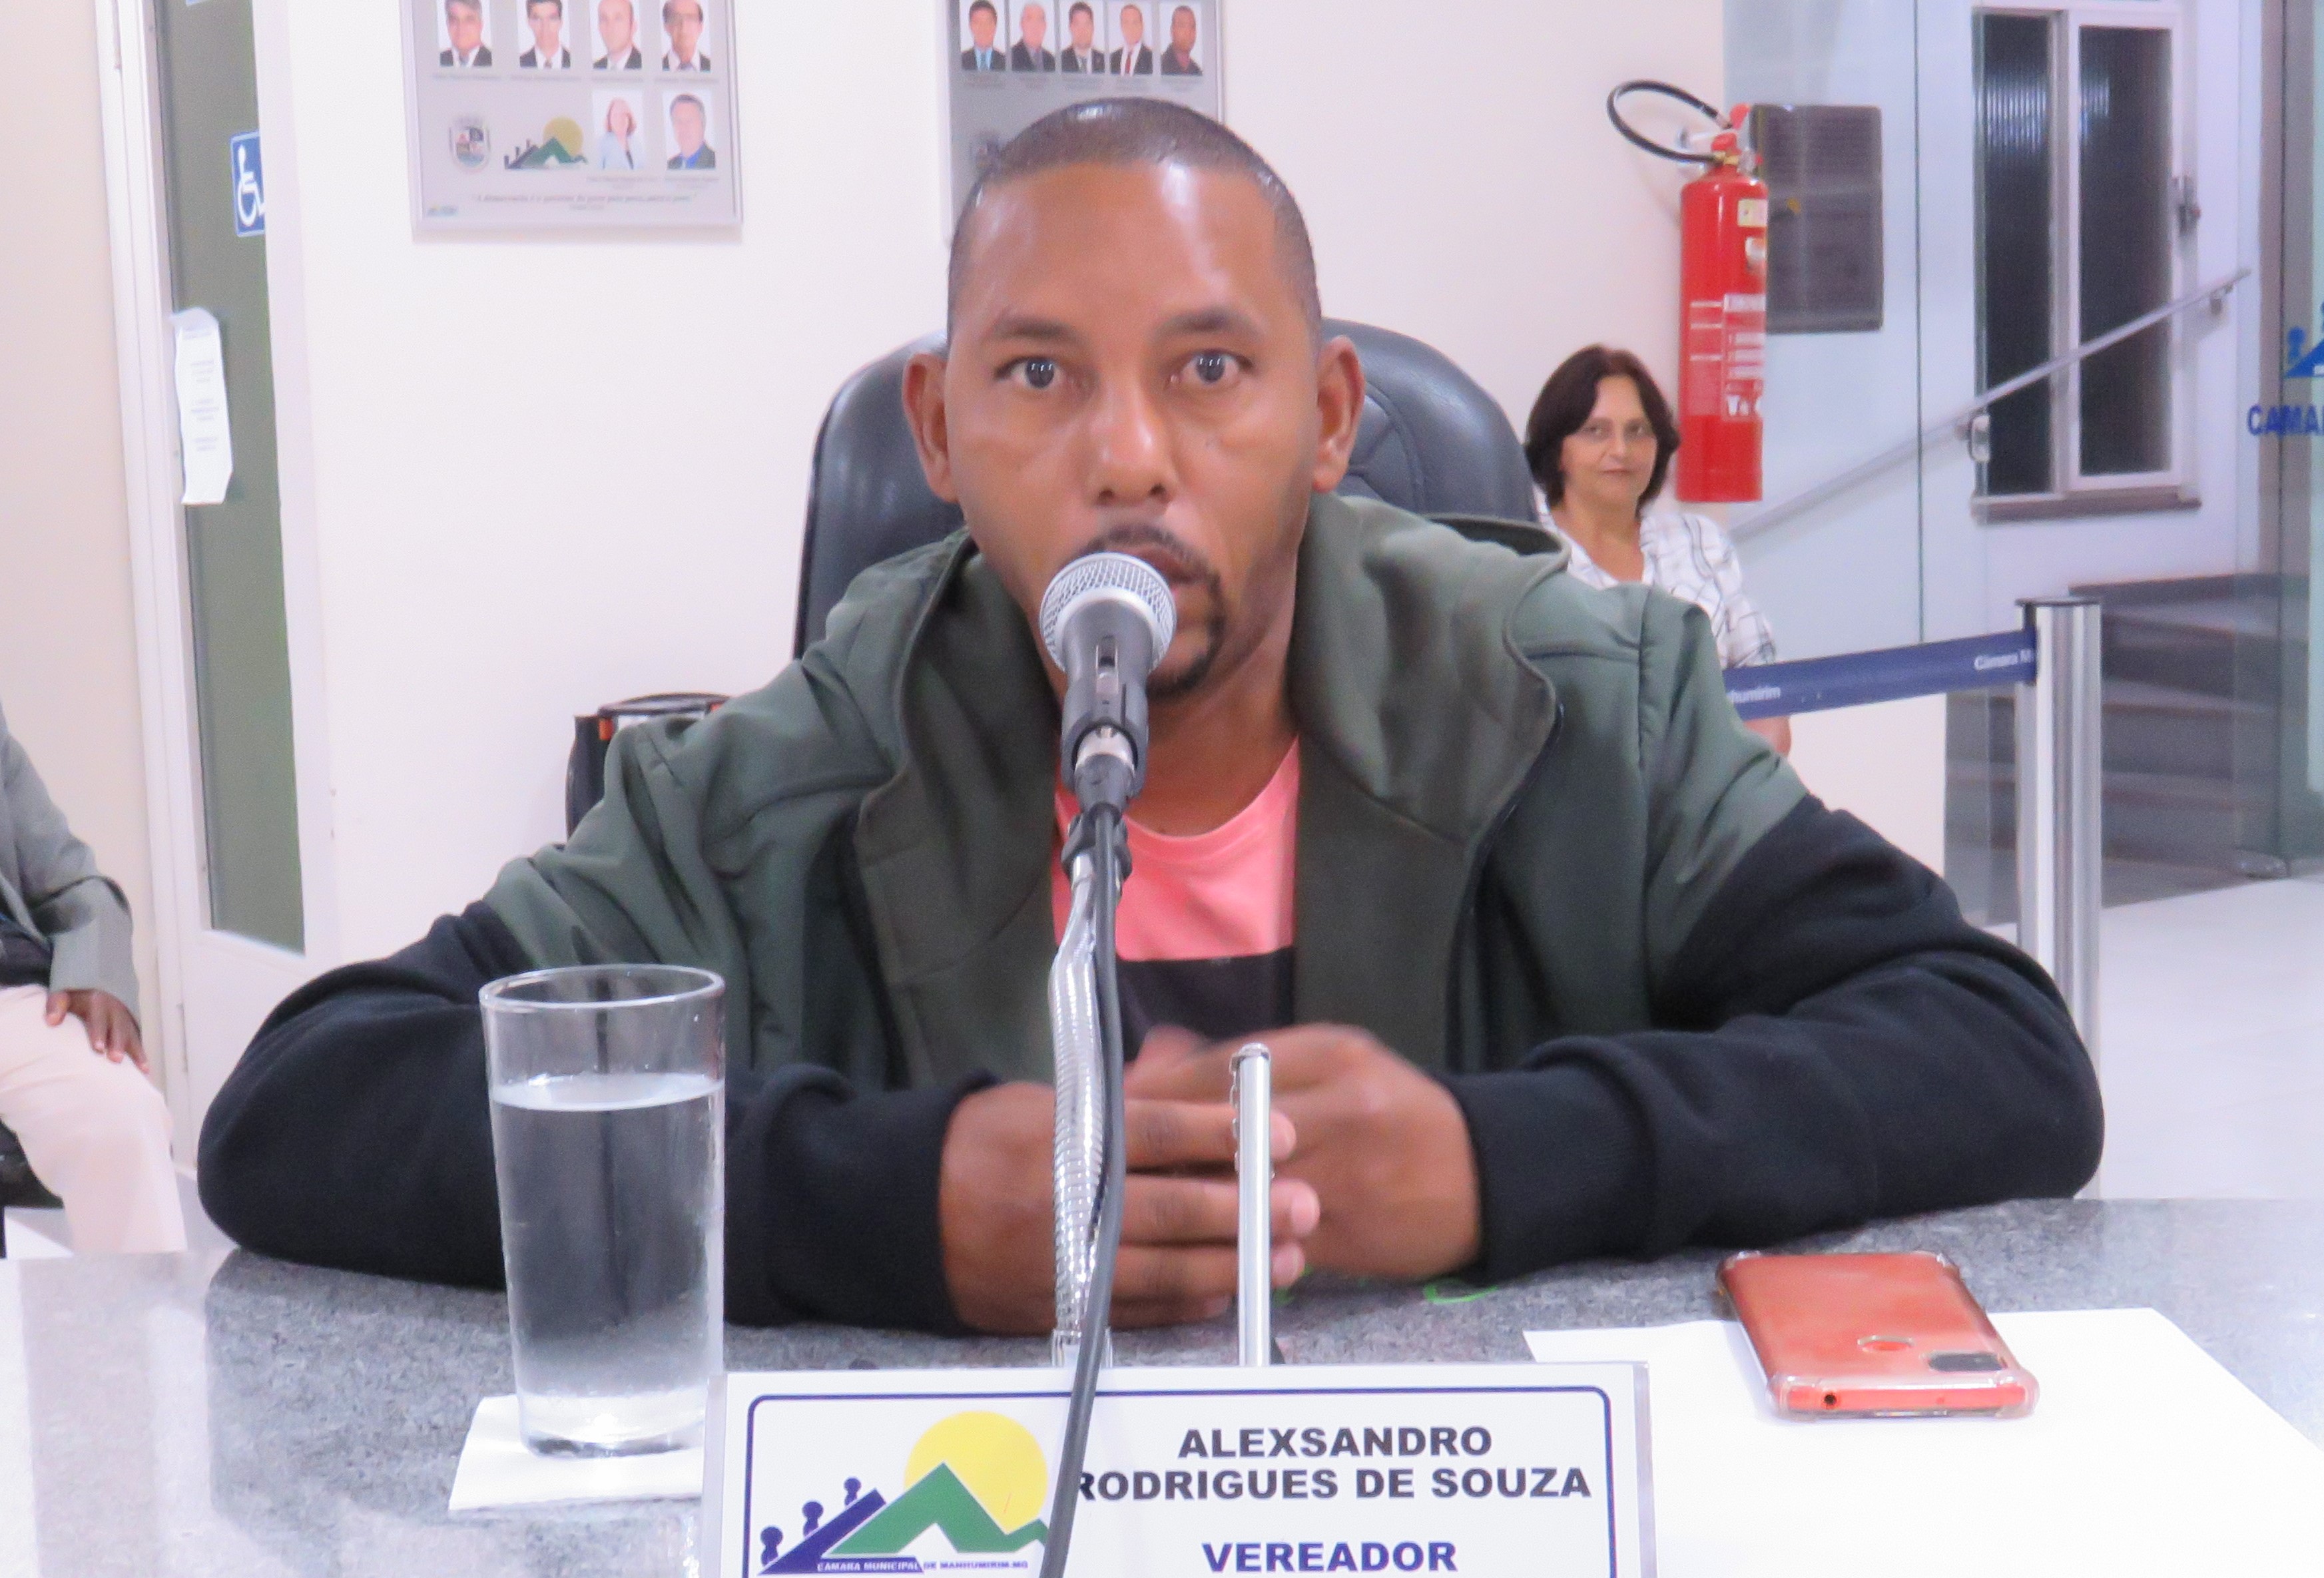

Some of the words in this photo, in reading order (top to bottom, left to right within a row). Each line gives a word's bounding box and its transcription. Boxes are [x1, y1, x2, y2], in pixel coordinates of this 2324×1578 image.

[2247, 403, 2324, 437] CAMA
[1178, 1426, 1492, 1457] ALEXSANDRO
[1356, 1469, 1414, 1497] DE
[1432, 1467, 1591, 1497] SOUZA
[863, 1561, 919, 1571] MUNICIPAL
[1203, 1541, 1457, 1572] VEREADOR
